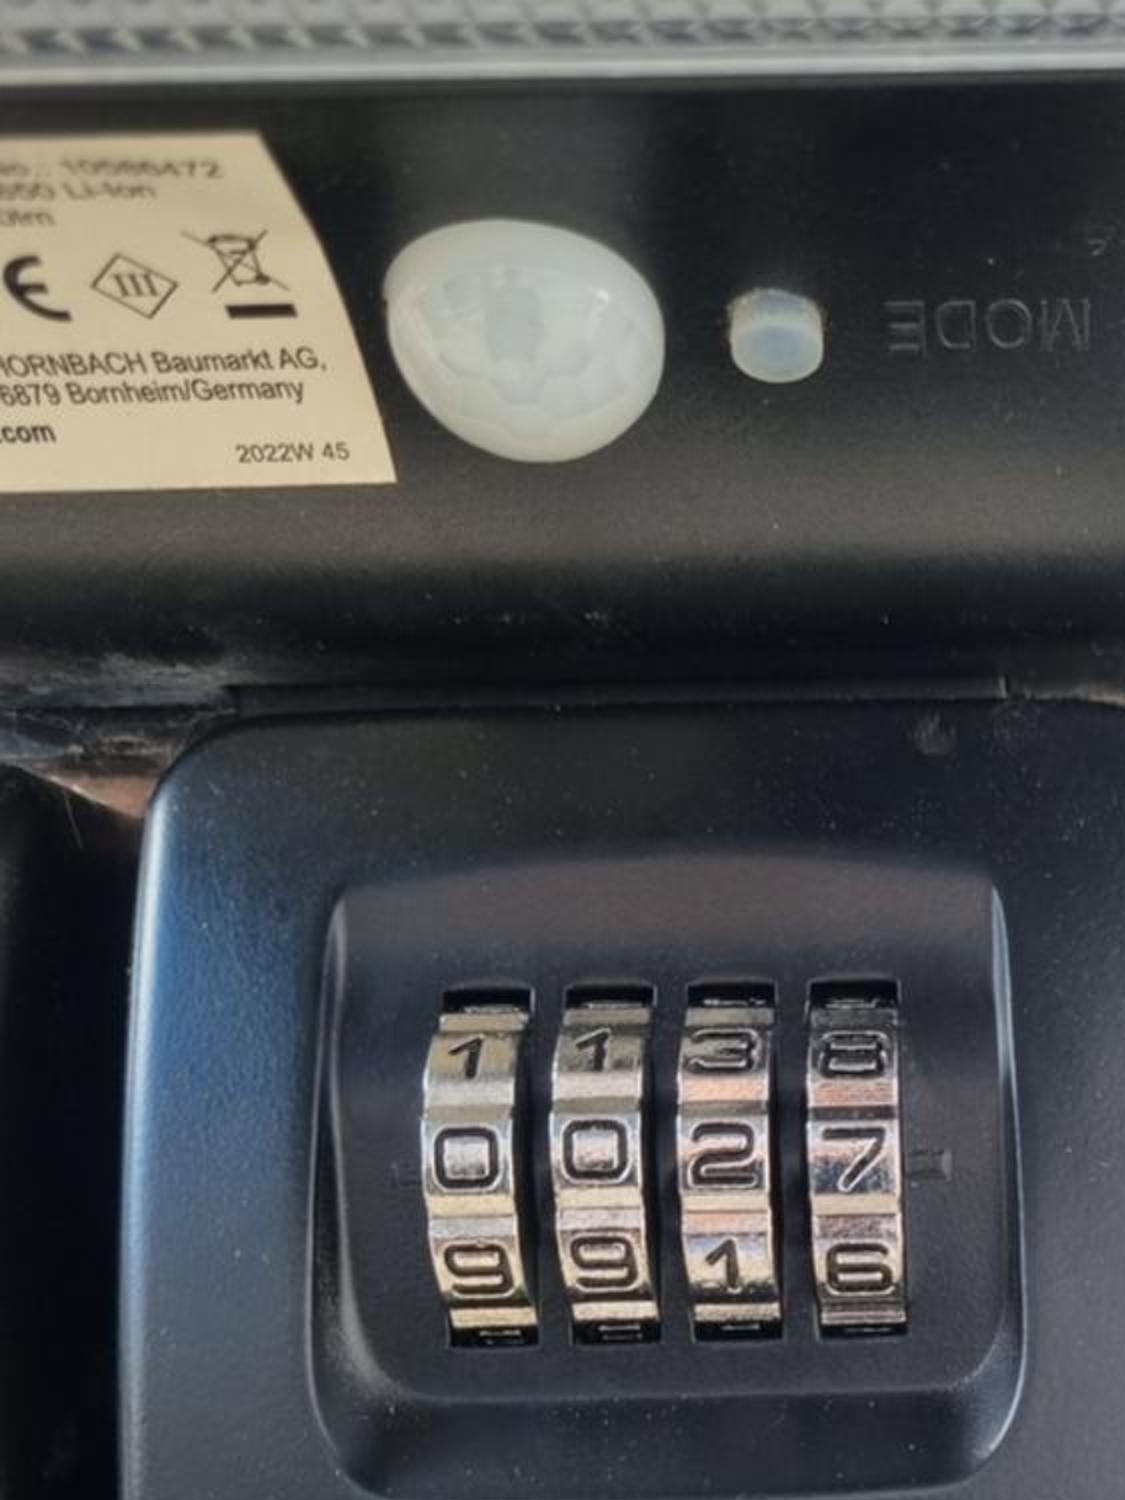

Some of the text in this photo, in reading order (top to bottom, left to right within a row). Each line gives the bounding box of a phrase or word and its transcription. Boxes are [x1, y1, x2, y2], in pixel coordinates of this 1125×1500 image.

[885, 297, 1091, 352] MODE
[151, 350, 274, 374] Baumarkt
[279, 346, 327, 372] AG,
[65, 378, 304, 404] Bornheim/Germany
